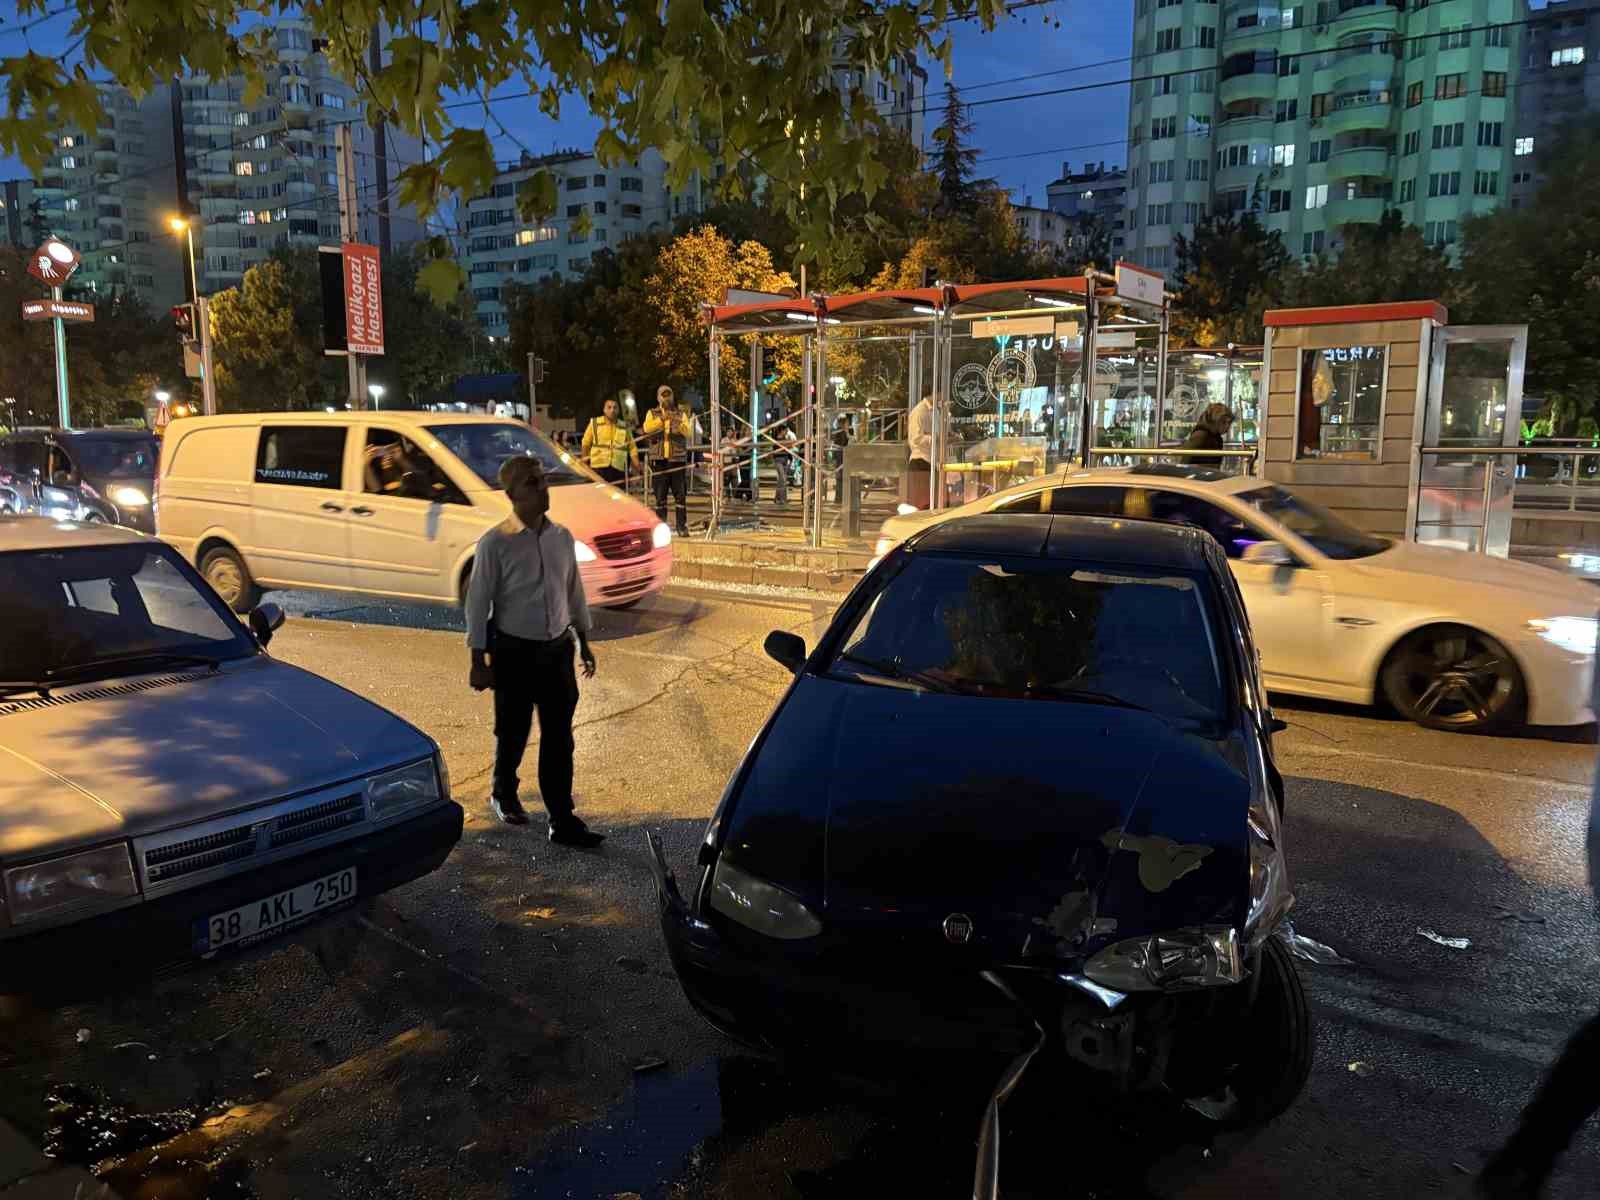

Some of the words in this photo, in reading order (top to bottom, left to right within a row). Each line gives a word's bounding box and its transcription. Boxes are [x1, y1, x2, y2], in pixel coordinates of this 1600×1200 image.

[347, 255, 366, 342] Melikgazi
[362, 255, 380, 343] Hastanesi
[211, 912, 241, 944] 38
[258, 891, 302, 929] AKL
[313, 871, 352, 908] 250
